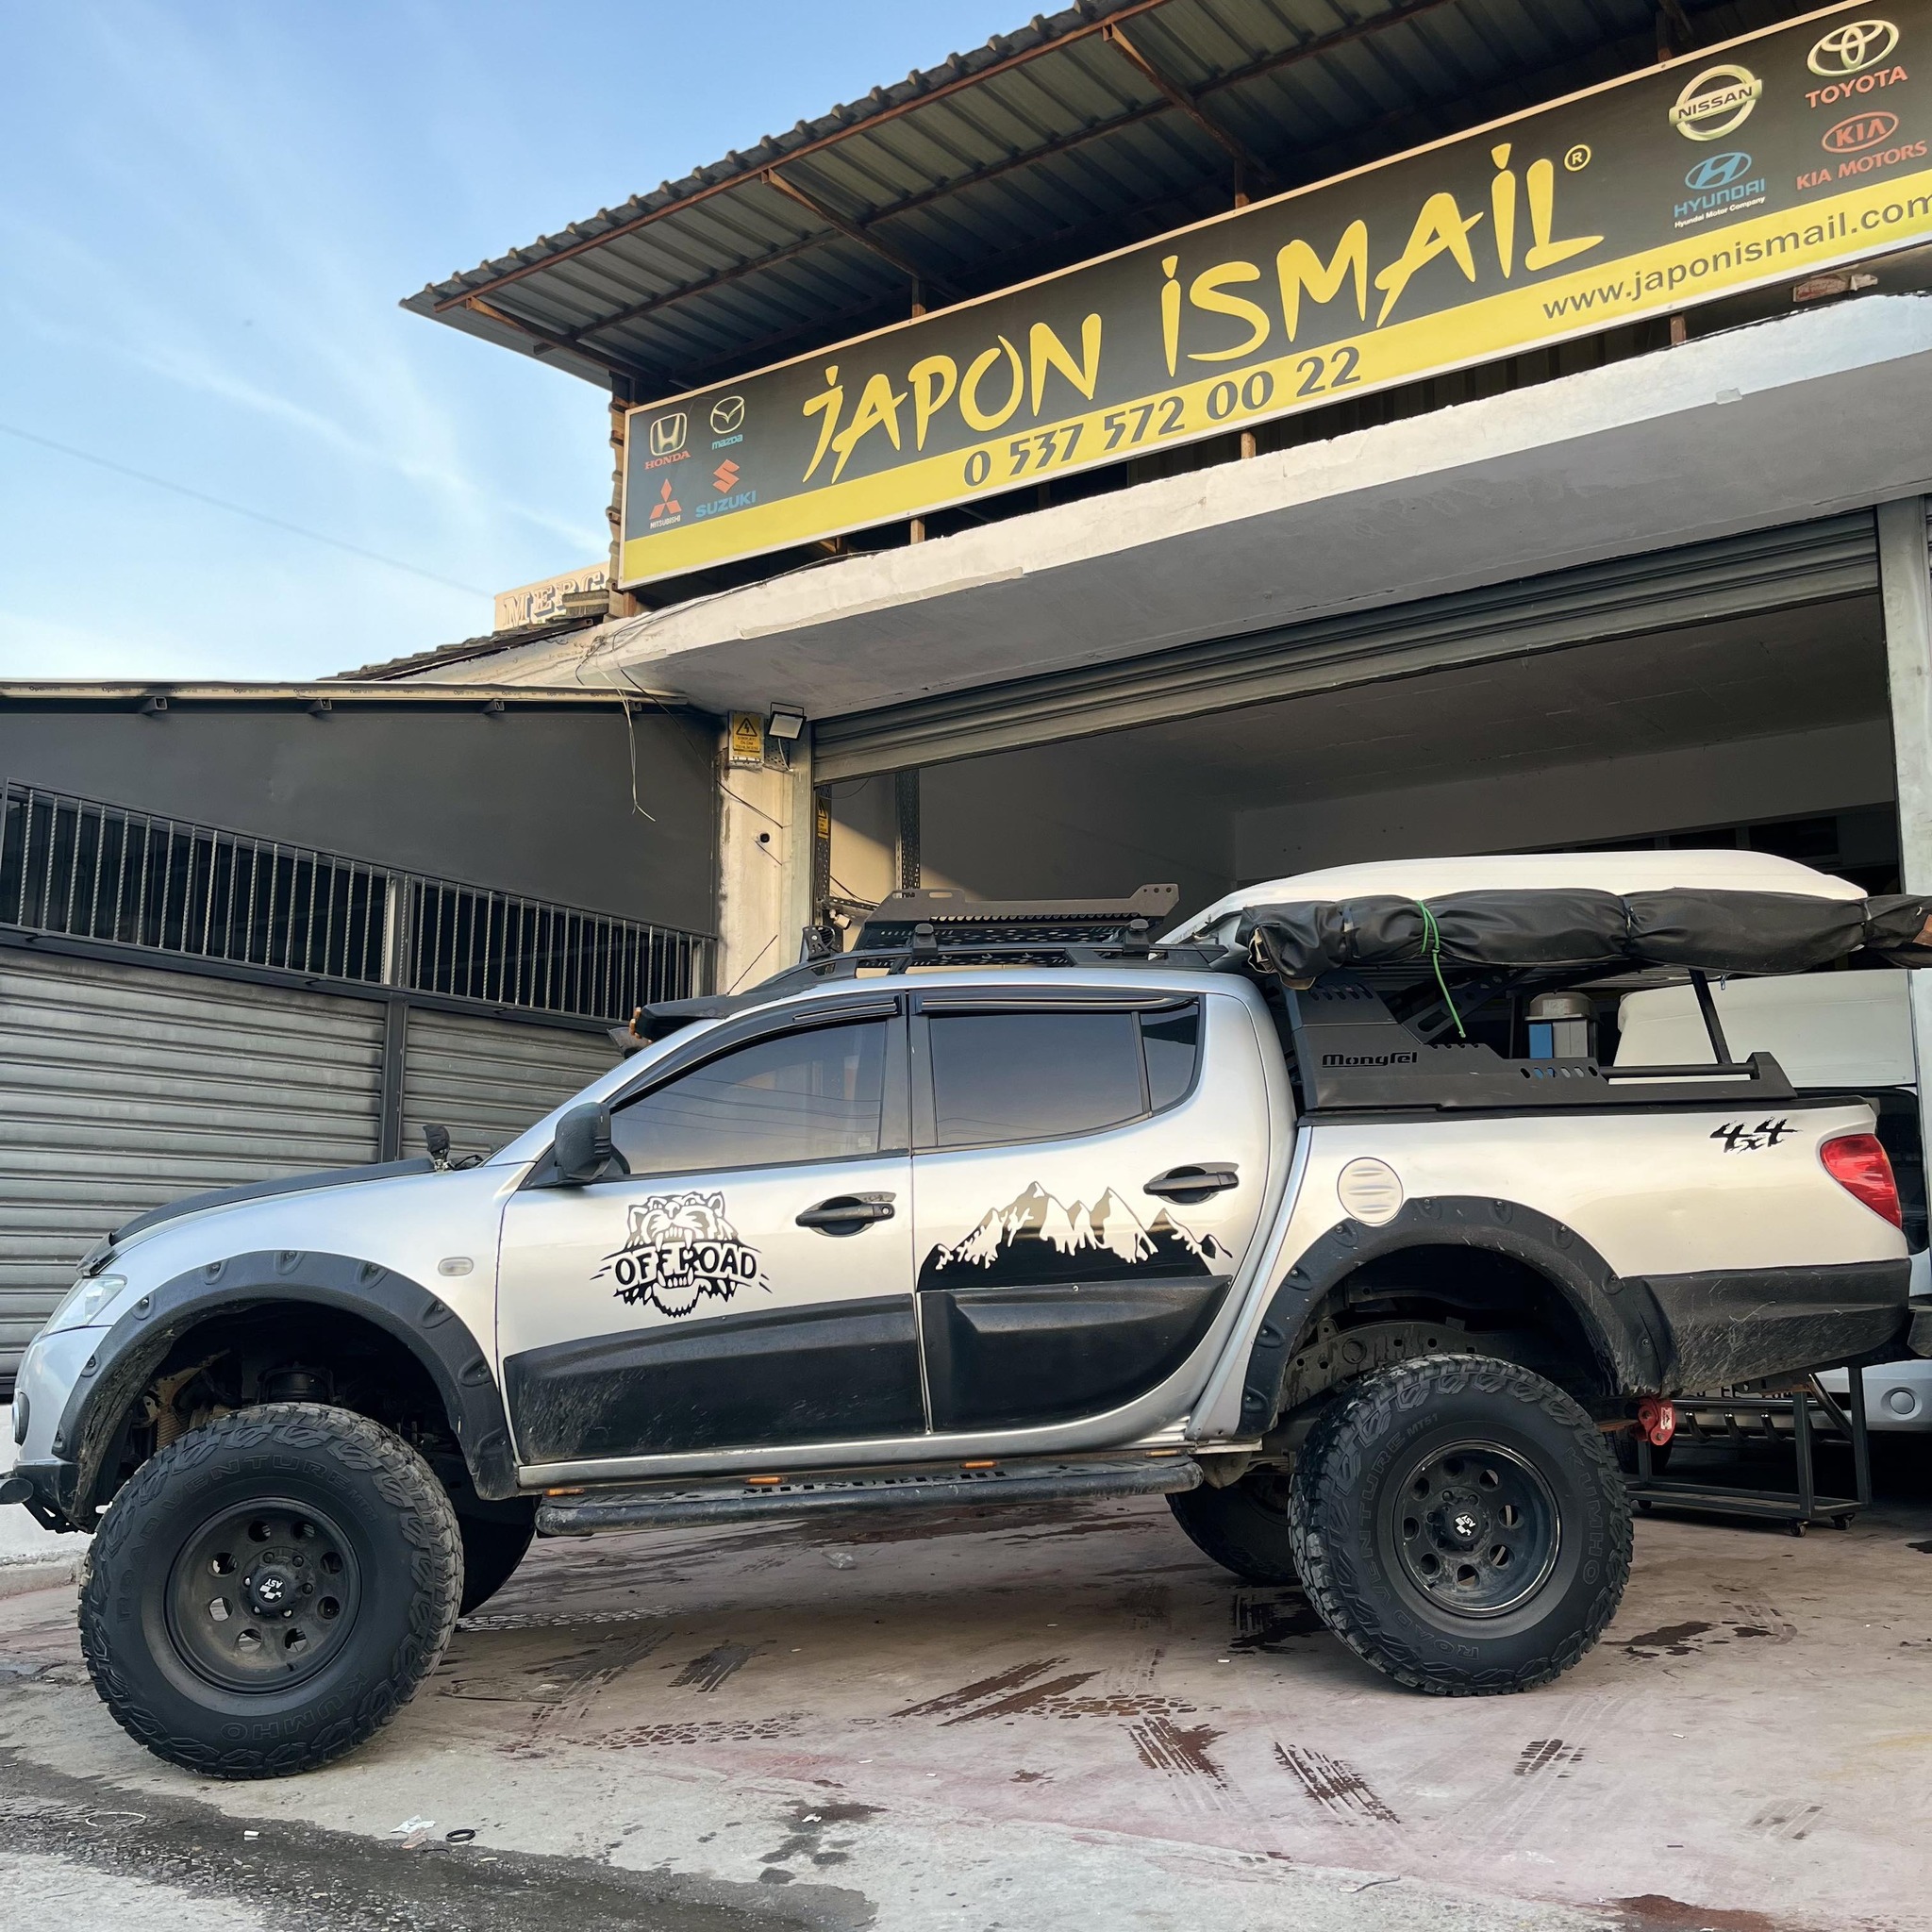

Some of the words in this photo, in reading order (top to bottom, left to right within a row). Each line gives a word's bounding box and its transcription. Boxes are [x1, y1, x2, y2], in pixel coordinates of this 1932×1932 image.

[1677, 86, 1754, 120] NISSAN
[1805, 65, 1909, 109] TOYOTA
[1836, 118, 1887, 148] KIA
[1796, 168, 1832, 191] KIA
[1838, 140, 1928, 179] MOTORS
[1674, 177, 1766, 218] HYUNDAI
[1674, 213, 1705, 228] Hyundai
[1706, 207, 1728, 219] Motor
[1729, 196, 1766, 211] Company
[1543, 194, 1932, 320] www.japonismail.com
[964, 450, 991, 487] 0
[1009, 424, 1084, 476] 537
[1104, 396, 1185, 451] 572
[1206, 370, 1274, 420] 00
[1295, 346, 1361, 397] 22
[644, 450, 691, 470] HONDA
[711, 433, 743, 450] mazda
[650, 515, 680, 529] MITSUBISHI
[695, 491, 756, 518] SUZUKI
[162, 1453, 351, 1510] VENTURE
[1358, 1431, 1407, 1606] VENTURE
[1562, 1446, 1602, 1586] KUMHO
[265, 1578, 283, 1589] ASY
[221, 1672, 371, 1741] KUMHO
